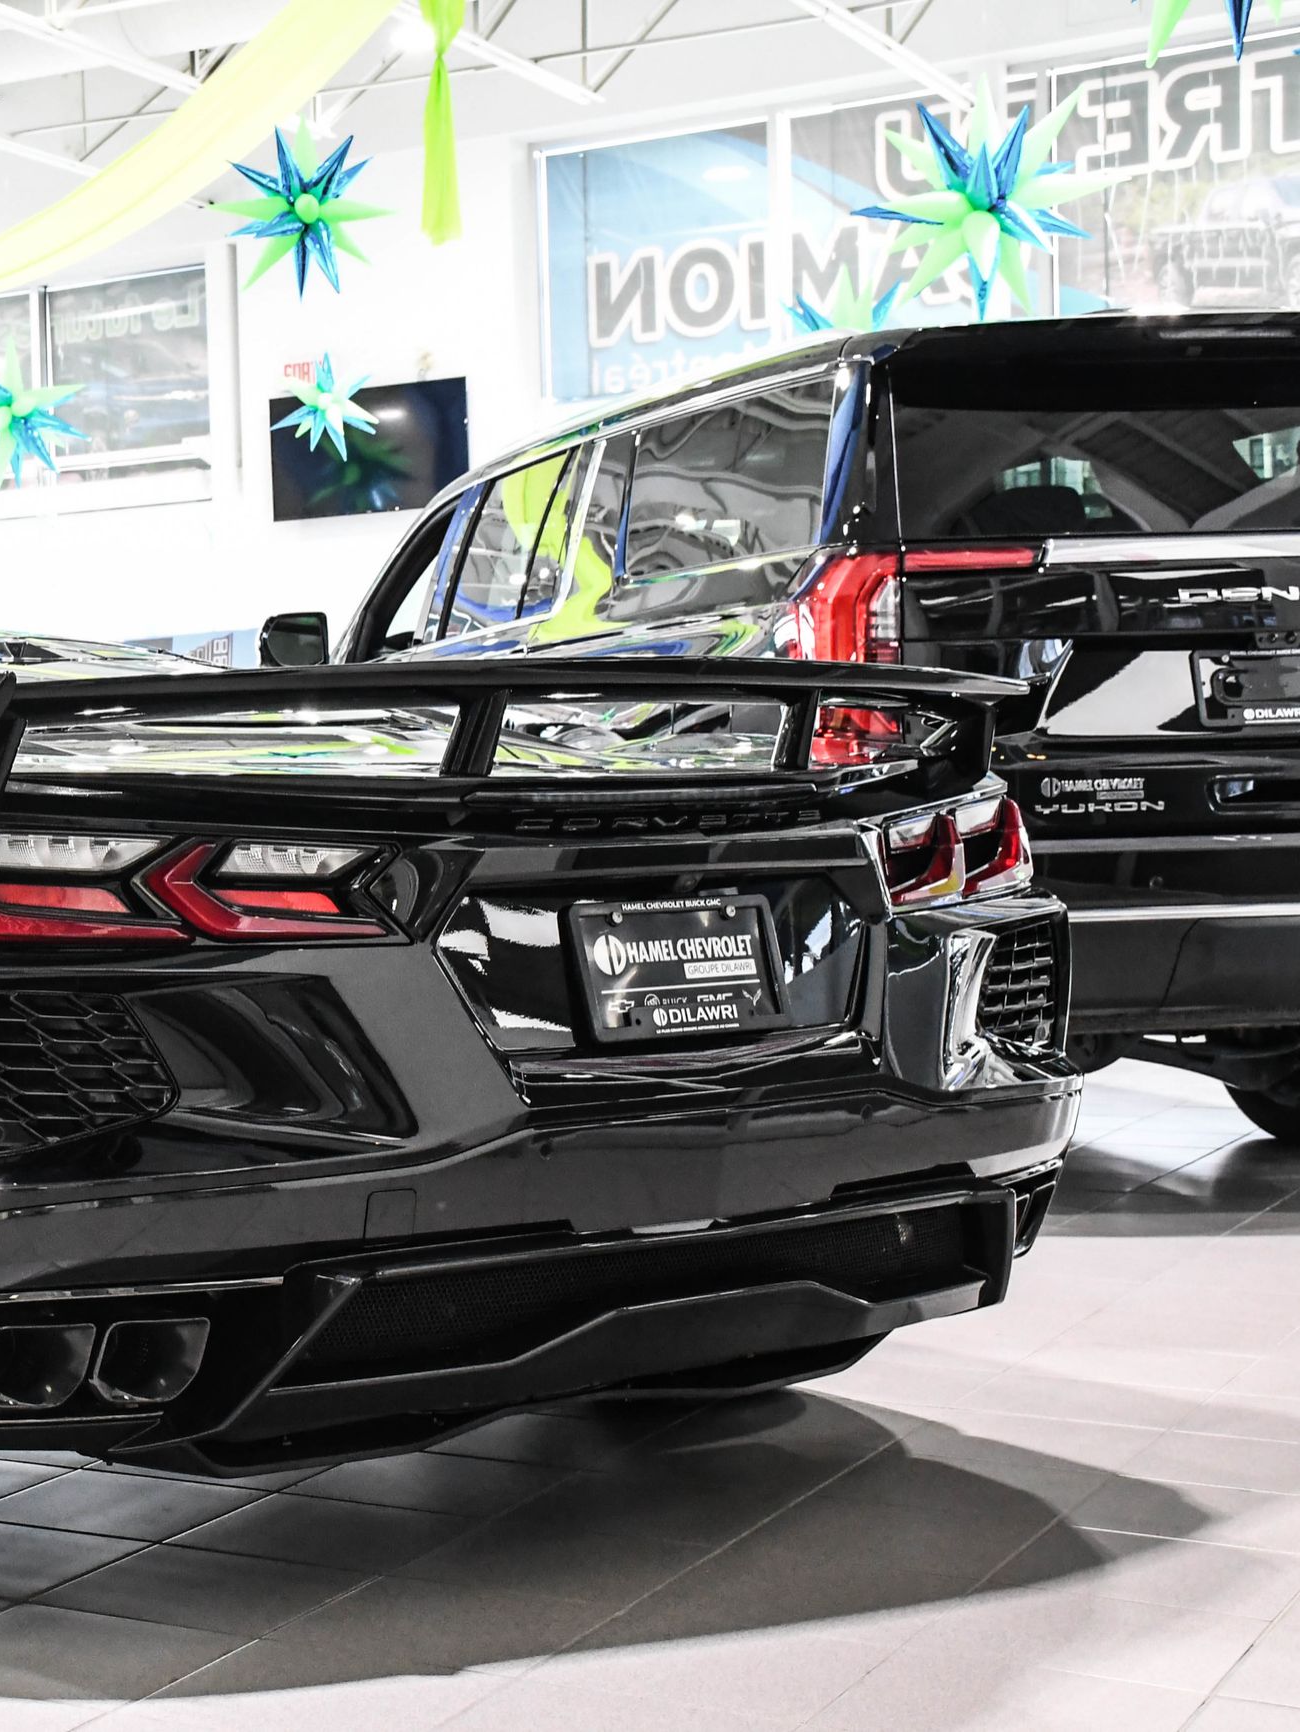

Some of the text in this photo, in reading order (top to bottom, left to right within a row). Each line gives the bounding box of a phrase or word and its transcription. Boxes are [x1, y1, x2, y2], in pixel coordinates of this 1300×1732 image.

[1035, 801, 1165, 815] YUKON
[621, 898, 721, 911] HAMEL CHEVROLET BUICK GMC
[626, 934, 753, 963] HAMEL CHEVROLET
[687, 962, 753, 976] GROUPE DILAWRI
[669, 1004, 738, 1024] DILAWRI
